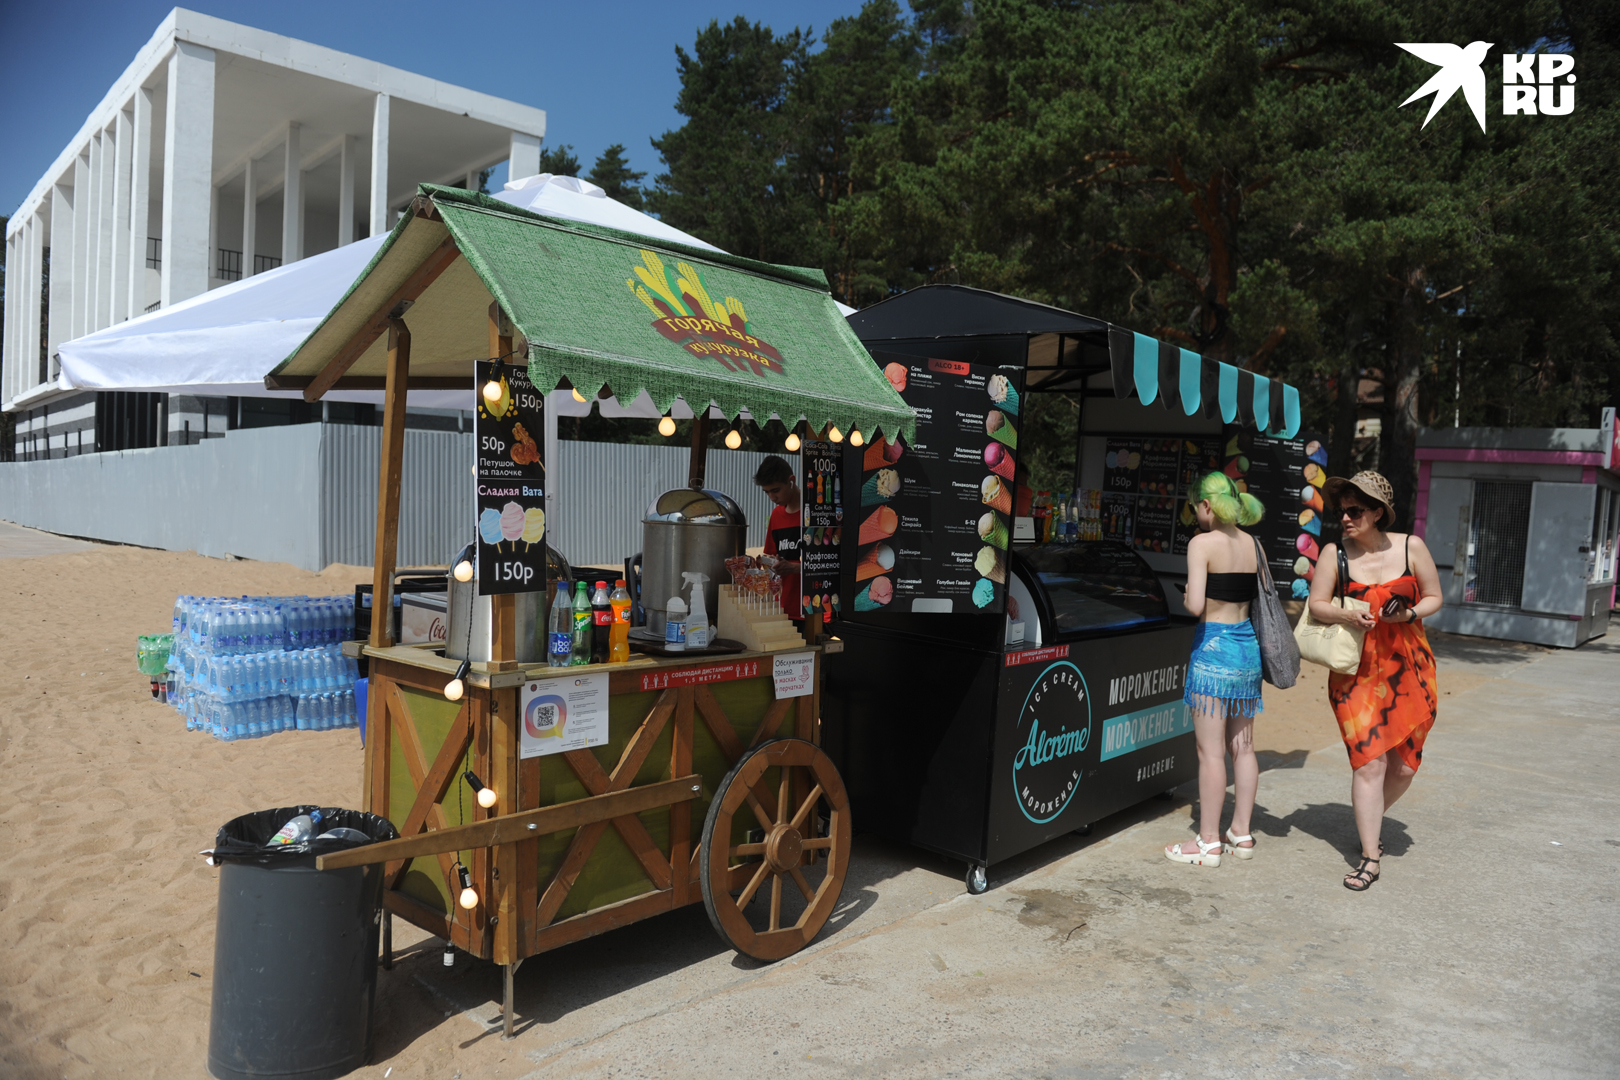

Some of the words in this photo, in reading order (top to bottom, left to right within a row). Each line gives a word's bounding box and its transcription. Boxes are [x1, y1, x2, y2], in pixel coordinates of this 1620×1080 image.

[664, 318, 760, 348] горячая
[935, 361, 952, 370] ALCO
[482, 436, 506, 454] 50р
[480, 458, 514, 468] Петушок
[813, 458, 836, 476] 100р
[478, 485, 520, 497] Сладкая
[522, 486, 543, 497] Вата
[806, 552, 838, 562] Крафтовое
[495, 562, 534, 585] 150р
[804, 561, 840, 572] Мороженое
[775, 658, 813, 667] Обслуживание
[671, 670, 702, 678] СОБЛЮДАЙ
[702, 666, 733, 674] ДИСТАНЦИЮ
[779, 684, 805, 693] перчатках
[1053, 672, 1084, 702] CREAM
[1108, 665, 1179, 706] МОРОЖЕНОЕ
[1105, 708, 1176, 753] МОРОЖЕНОЕ
[1136, 756, 1175, 782] #ALCREME
[1022, 769, 1078, 814] МОРОЖЕНОЕ
